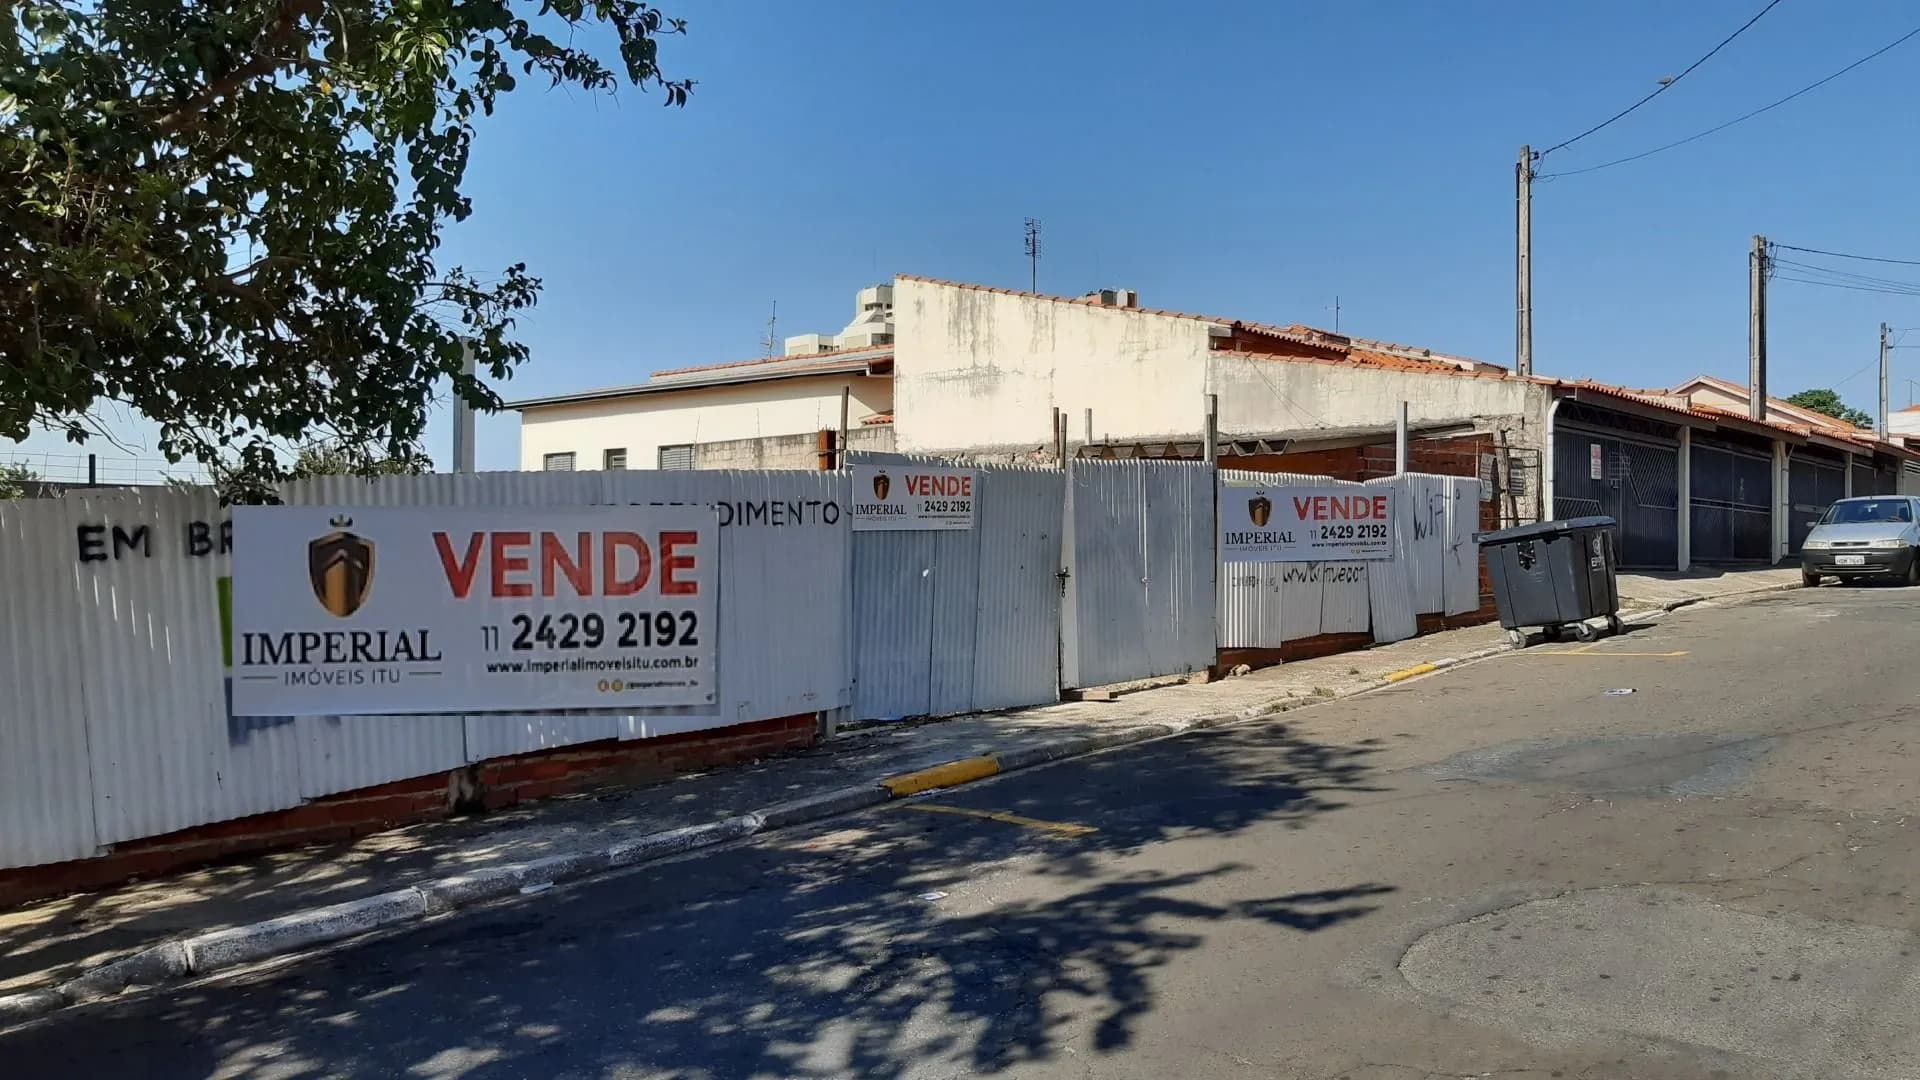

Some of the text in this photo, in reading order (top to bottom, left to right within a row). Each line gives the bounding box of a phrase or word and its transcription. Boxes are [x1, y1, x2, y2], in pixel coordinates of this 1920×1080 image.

[905, 475, 971, 497] VENDE
[856, 504, 907, 515] IMPERIAL
[925, 500, 948, 512] 2429
[951, 500, 971, 512] 2192
[1293, 495, 1387, 521] VENDE
[1225, 531, 1296, 545] IMPERIAL
[1320, 525, 1354, 540] 2429
[1357, 524, 1387, 538] 2192
[77, 525, 151, 562] EM
[432, 531, 698, 599] VENDE
[481, 610, 699, 651] 11 2429 2192
[241, 629, 442, 665] IMPERIAL
[486, 655, 699, 675] www.imperialimoveisitu.com.br
[284, 668, 401, 686] IMÓVEIS ITU
